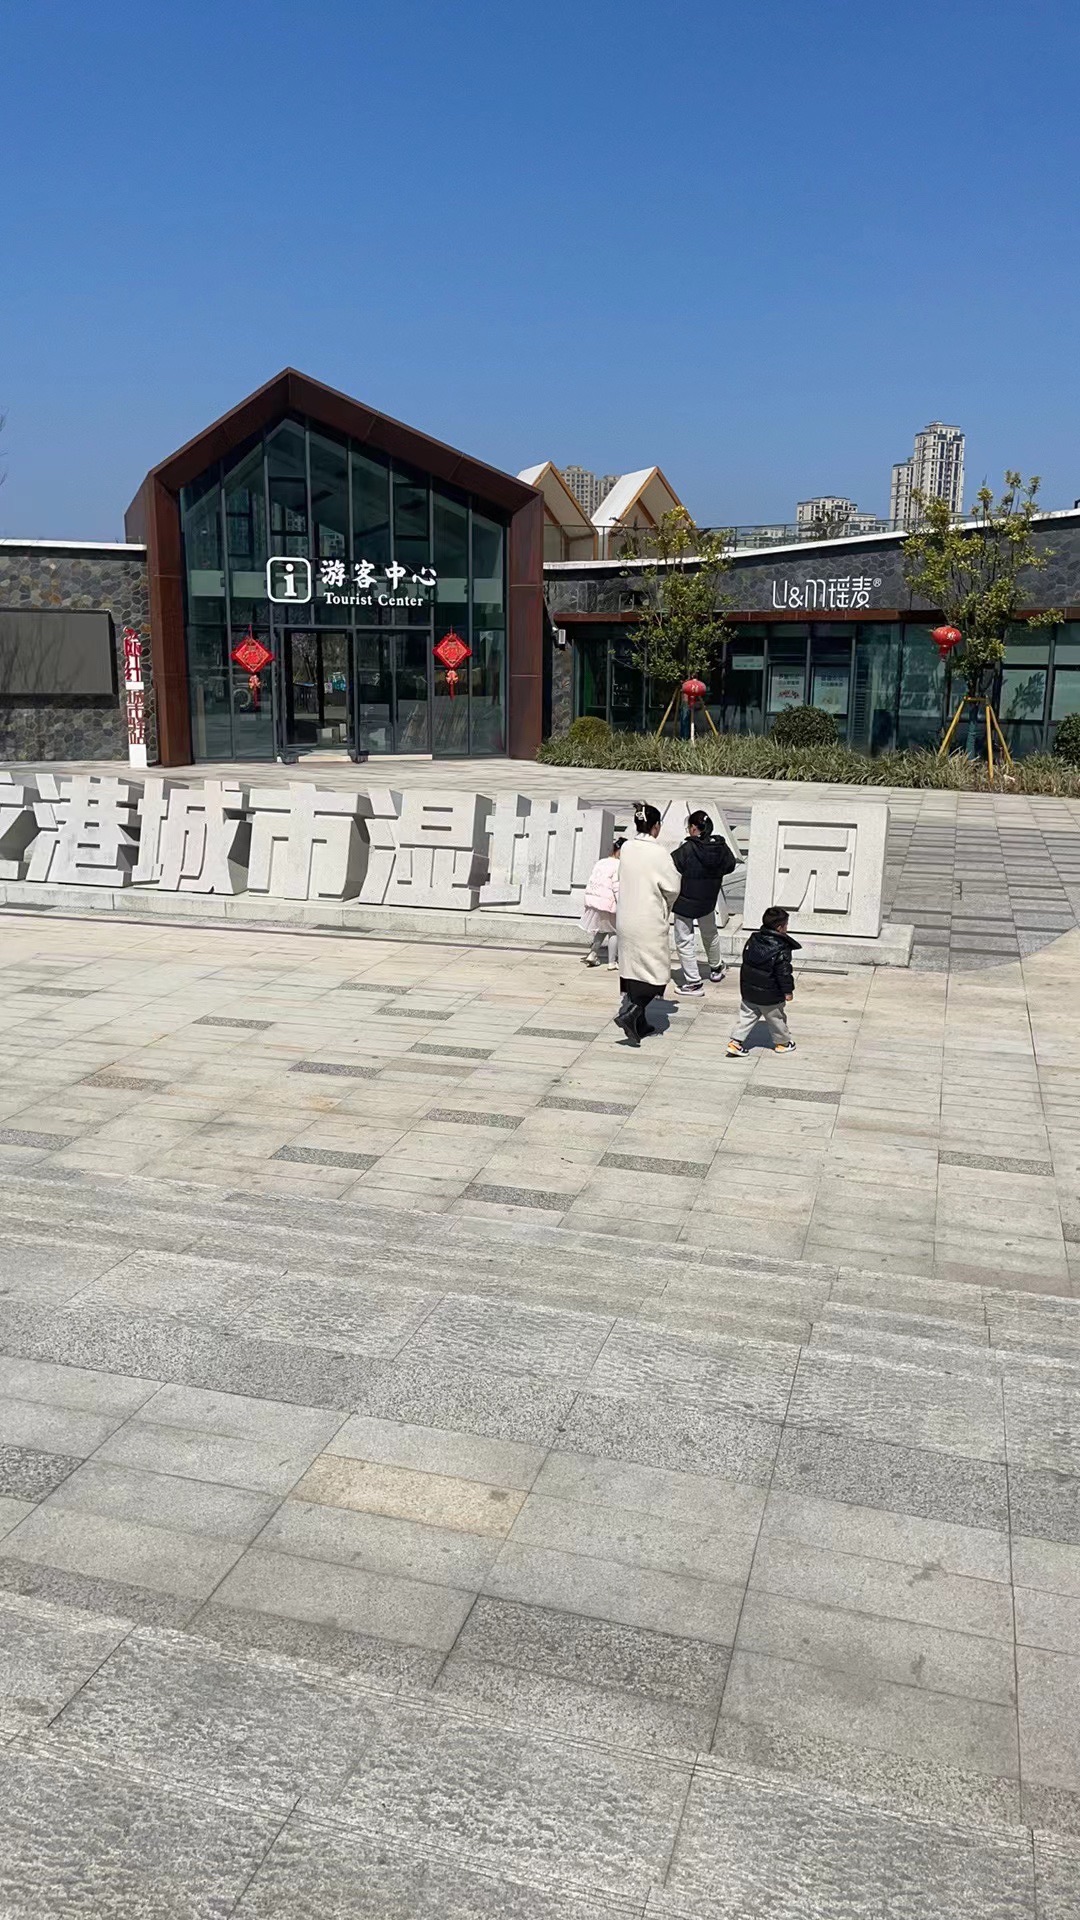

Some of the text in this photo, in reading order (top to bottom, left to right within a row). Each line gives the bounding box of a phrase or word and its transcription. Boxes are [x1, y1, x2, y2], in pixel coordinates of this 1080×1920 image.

[320, 559, 437, 590] 游客中心
[324, 592, 424, 607] Tourist Center
[0, 772, 888, 938] 港城市湿地园
